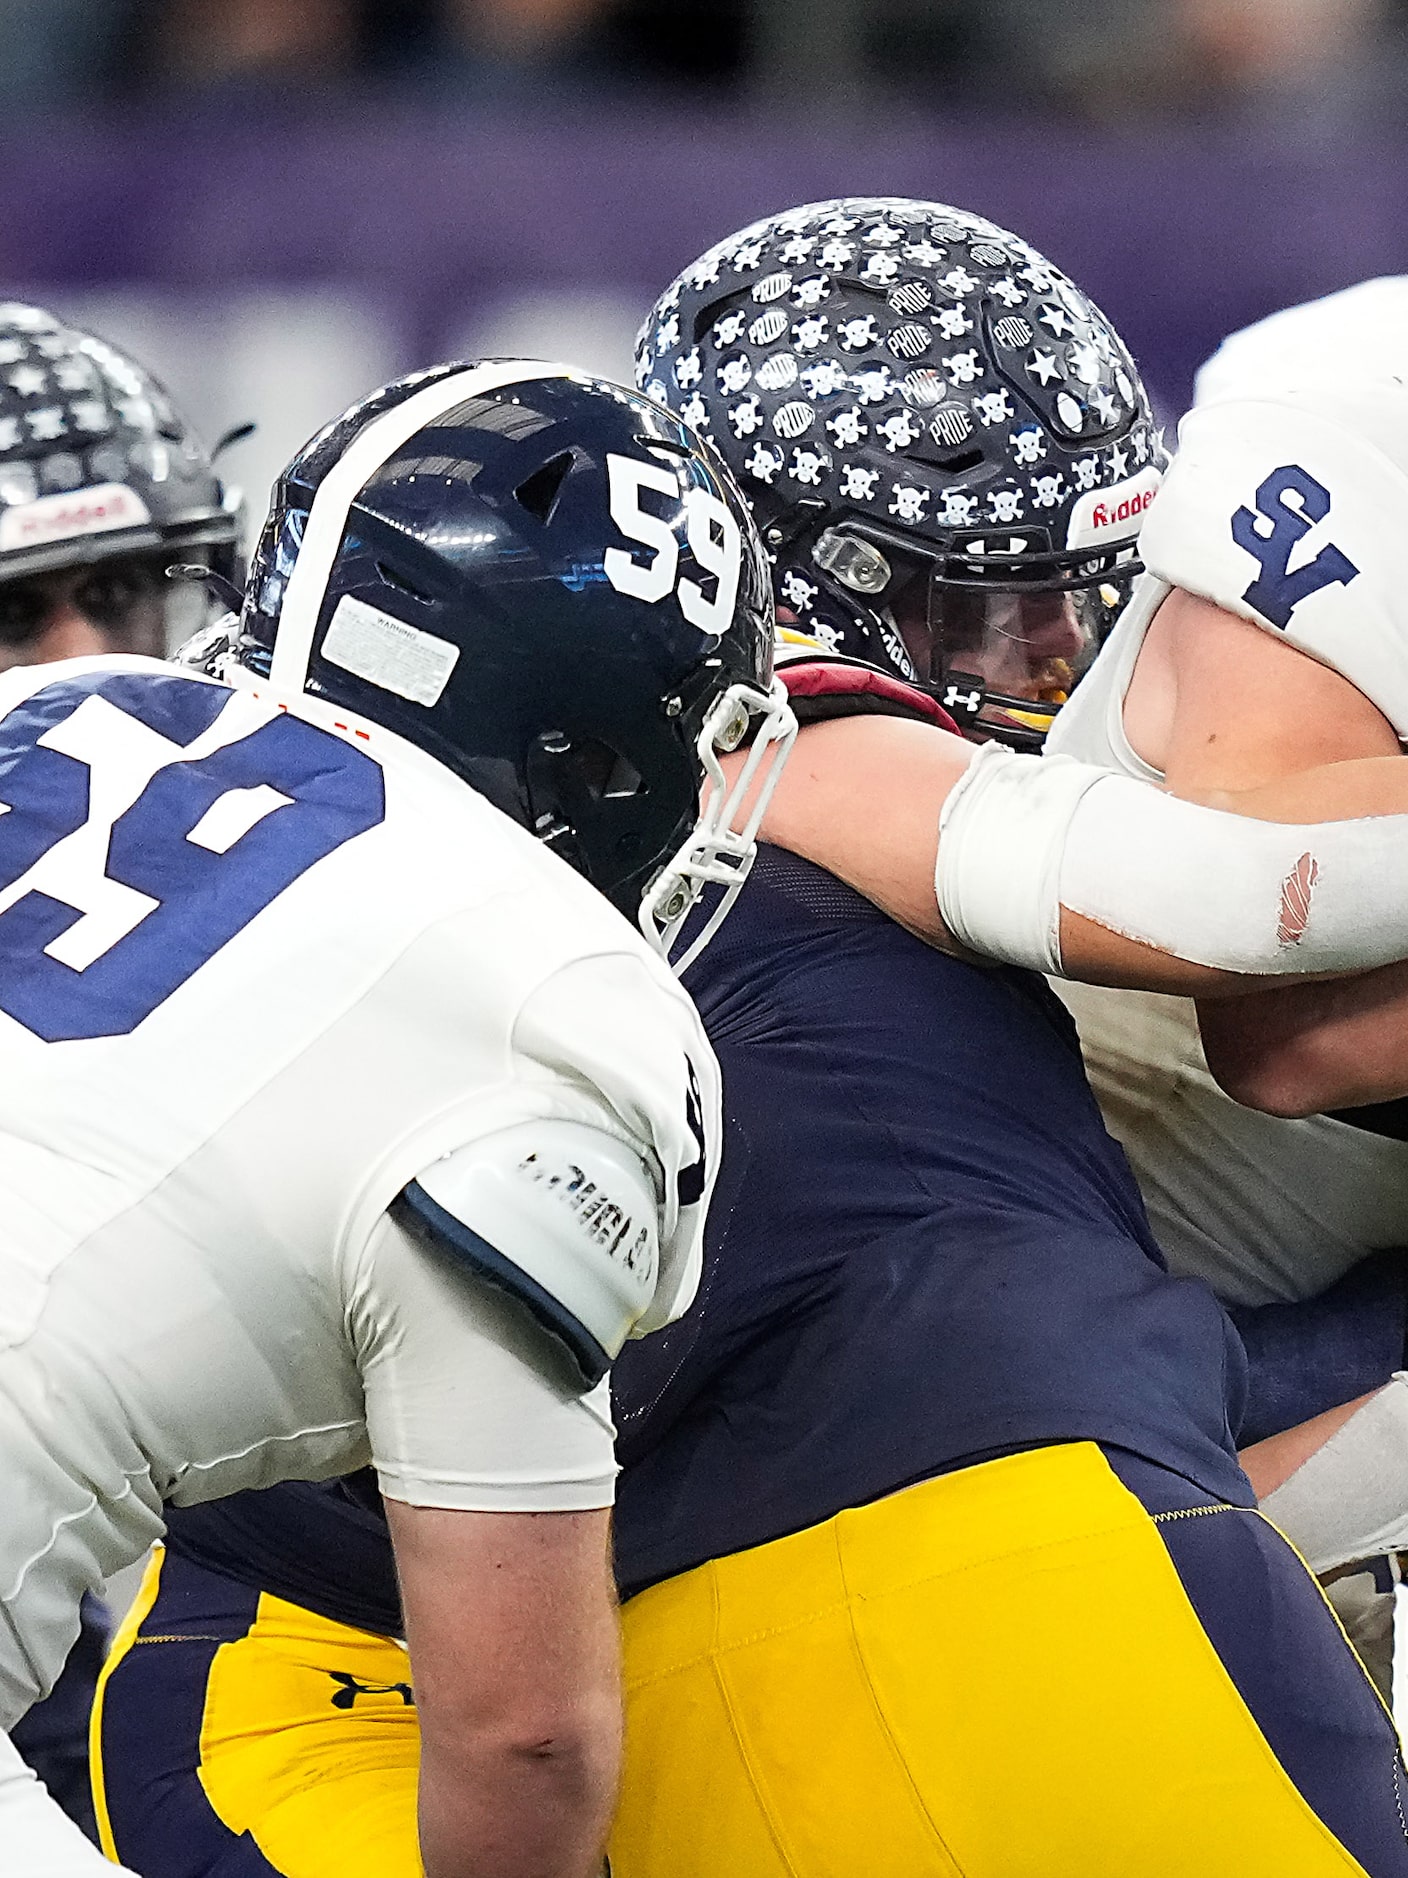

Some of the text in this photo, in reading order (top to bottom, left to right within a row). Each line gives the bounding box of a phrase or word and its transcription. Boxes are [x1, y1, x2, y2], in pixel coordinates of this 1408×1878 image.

[888, 281, 932, 317] PRIDE
[887, 325, 932, 358] PRIDE
[992, 315, 1034, 348] PRIDE
[929, 408, 974, 447] PRIDE
[603, 453, 741, 635] 59
[1230, 464, 1361, 631] SV
